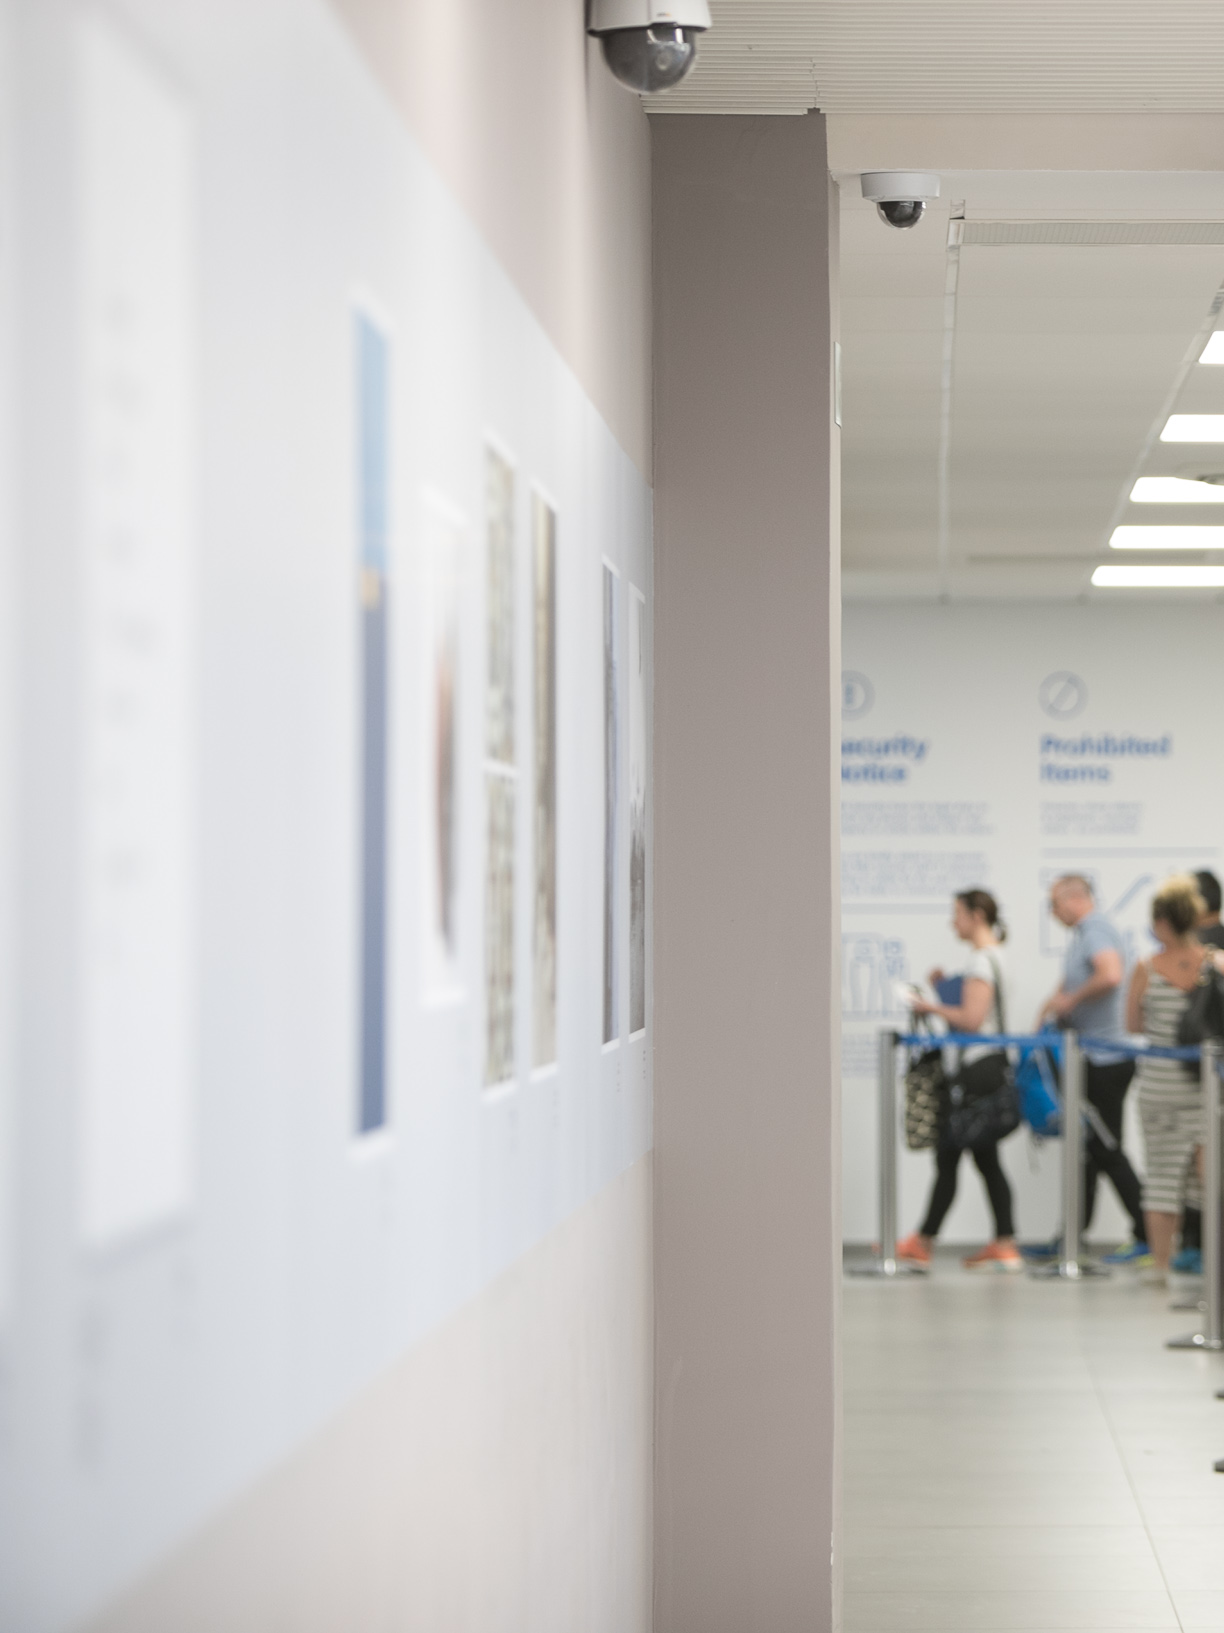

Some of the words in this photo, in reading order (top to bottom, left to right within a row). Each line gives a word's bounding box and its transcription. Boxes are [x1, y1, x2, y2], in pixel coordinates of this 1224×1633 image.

[841, 735, 927, 761] ecurity
[1040, 732, 1170, 757] Prohibited
[1040, 763, 1112, 782] Items
